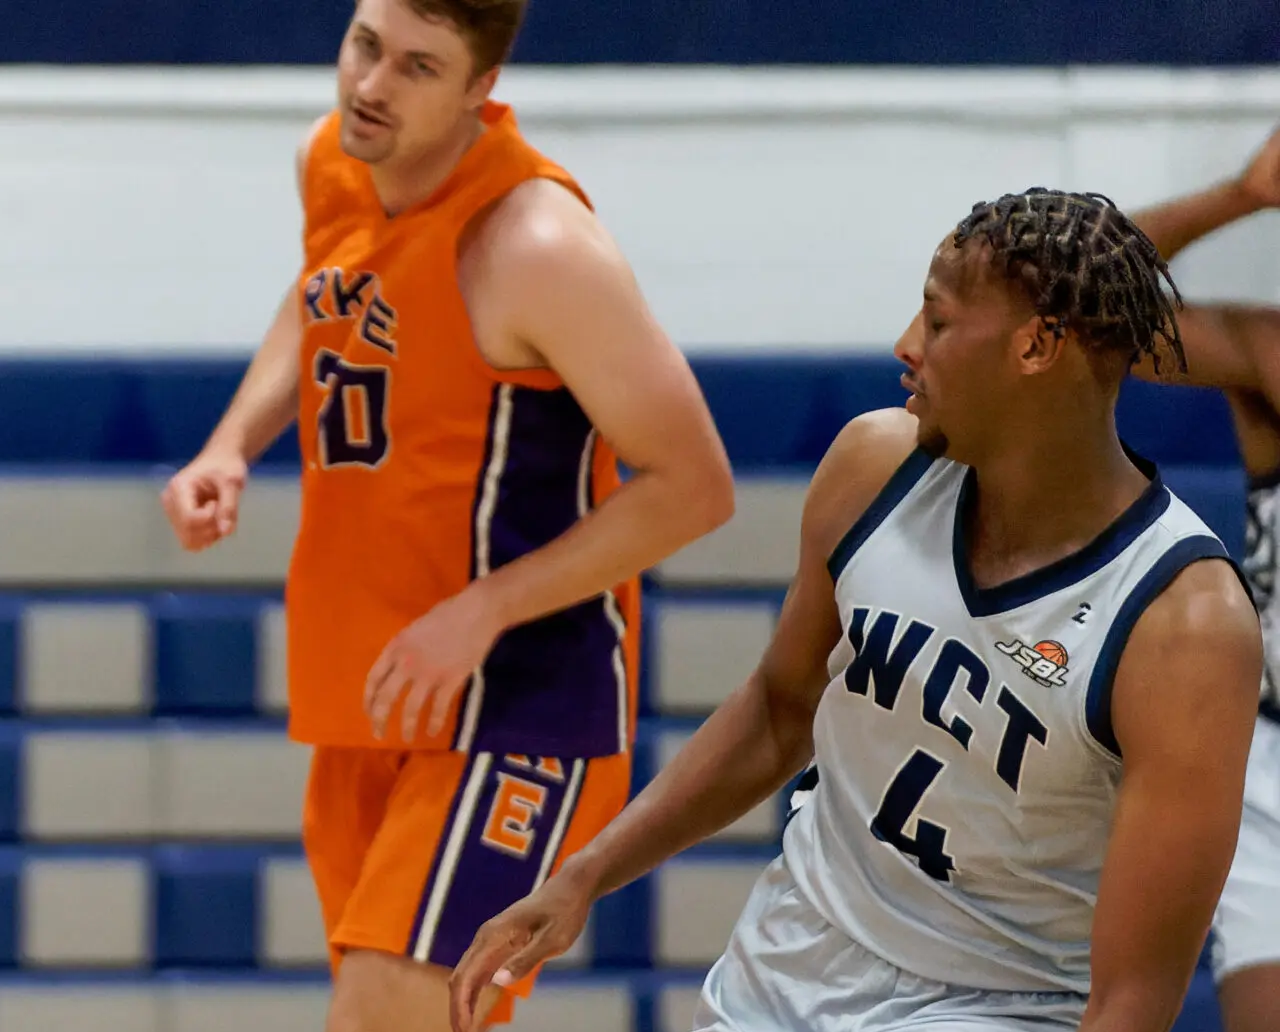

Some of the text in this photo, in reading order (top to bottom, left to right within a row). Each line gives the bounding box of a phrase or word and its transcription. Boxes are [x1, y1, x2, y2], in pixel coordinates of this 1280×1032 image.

[844, 606, 1050, 795] WCT
[994, 639, 1069, 687] JSBL
[870, 747, 958, 884] 4
